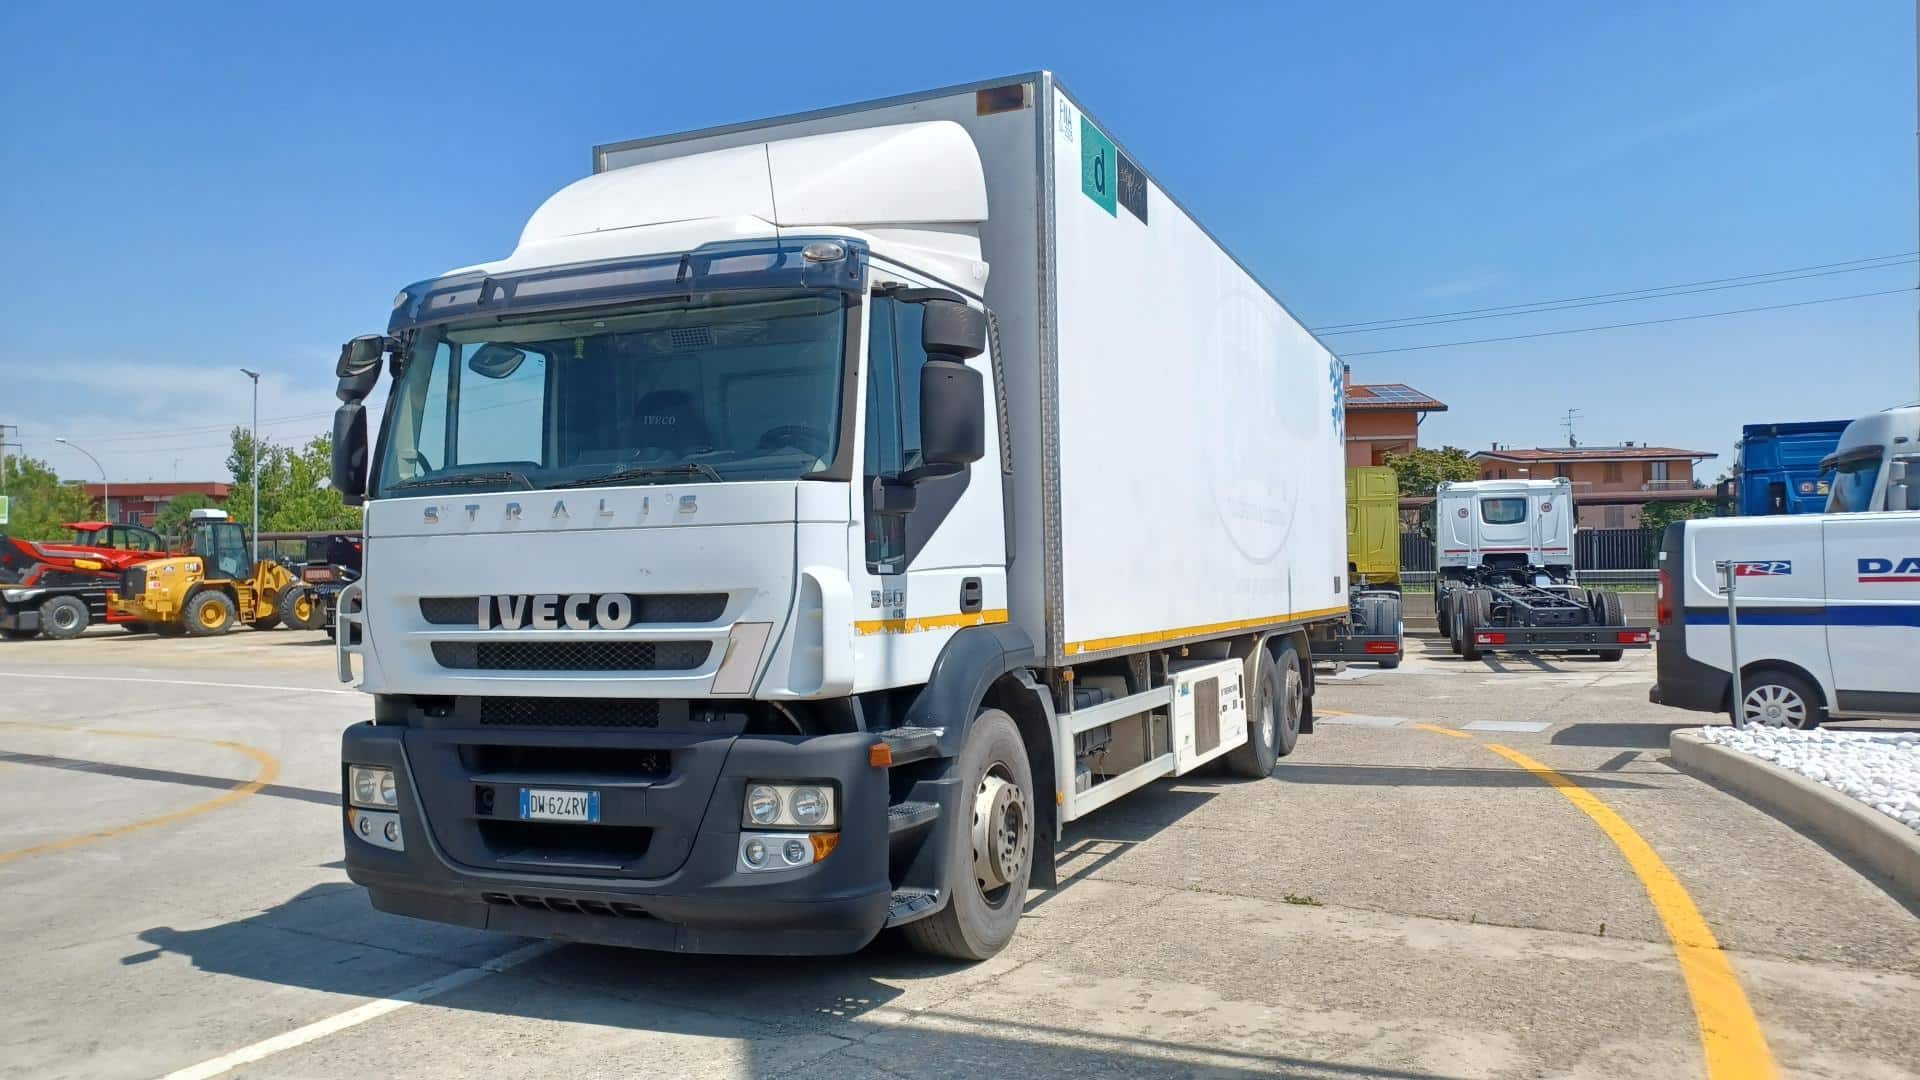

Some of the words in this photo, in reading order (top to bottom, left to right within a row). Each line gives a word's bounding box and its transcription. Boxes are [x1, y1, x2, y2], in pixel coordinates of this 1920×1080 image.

[1094, 147, 1105, 195] d
[423, 494, 698, 525] STRALIS
[478, 593, 632, 630] IVECO
